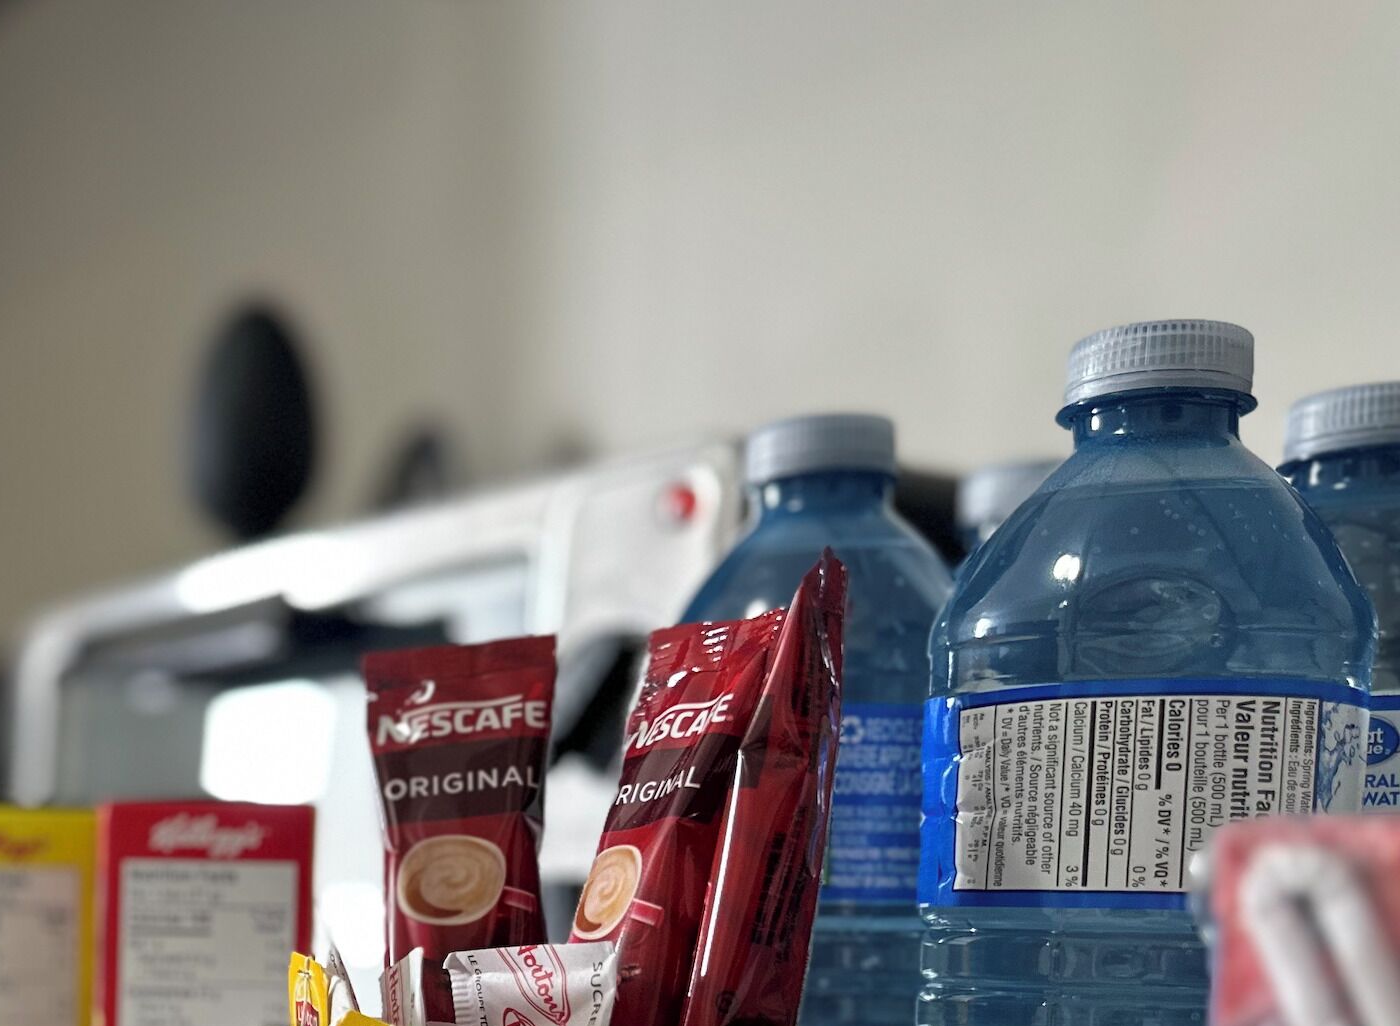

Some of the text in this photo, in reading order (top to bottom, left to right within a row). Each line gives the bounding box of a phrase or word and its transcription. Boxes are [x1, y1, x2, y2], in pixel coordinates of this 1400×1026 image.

[1048, 703, 1061, 722] Not
[1098, 701, 1112, 742] Protein
[1141, 700, 1155, 718] Fat
[1195, 700, 1208, 726] pour
[1216, 700, 1230, 720] Per
[1001, 718, 1012, 730] DV
[1030, 704, 1043, 754] nutrients.
[1072, 702, 1087, 745] Calcium
[1166, 700, 1185, 771] Calories 0
[1000, 738, 1012, 758] Daily
[1116, 700, 1133, 776] Carbohydrate
[1138, 728, 1153, 770] Lipides
[1213, 735, 1228, 768] bottle
[1258, 701, 1280, 782] Nutrition
[1000, 760, 1011, 781] Value
[1044, 735, 1060, 790] significant
[1193, 743, 1209, 793] bouteille
[1230, 700, 1256, 822] Valeur nutrit
[1288, 761, 1299, 777] Eau
[1300, 701, 1316, 815] Ingredients: Spring Wate
[385, 765, 539, 801] ORIGINAL
[615, 766, 700, 805] RIGINAL
[1011, 706, 1029, 845] d'autres éléments nutritifs.
[1028, 765, 1041, 802] Source
[1070, 756, 1085, 799] Calcium
[1094, 752, 1110, 805] Protéines
[1210, 772, 1225, 800] (500
[1287, 780, 1297, 790] de
[1001, 796, 1010, 808] VQ
[1043, 793, 1055, 829] source
[1069, 802, 1082, 816] 40
[1113, 786, 1129, 835] Glucides
[1158, 794, 1172, 806] %
[1189, 797, 1206, 824] (500
[1286, 793, 1294, 815] sour
[996, 817, 1009, 840] valeur
[1066, 819, 1079, 836] mg
[1207, 804, 1224, 827] mL)
[1025, 806, 1039, 865] négligeable
[1042, 832, 1054, 842] of
[1187, 828, 1204, 852] mL)
[993, 841, 1005, 886] quotidienne
[1041, 846, 1053, 874] other
[1155, 847, 1168, 859] %
[1065, 876, 1078, 887] %
[1132, 877, 1145, 887] %
